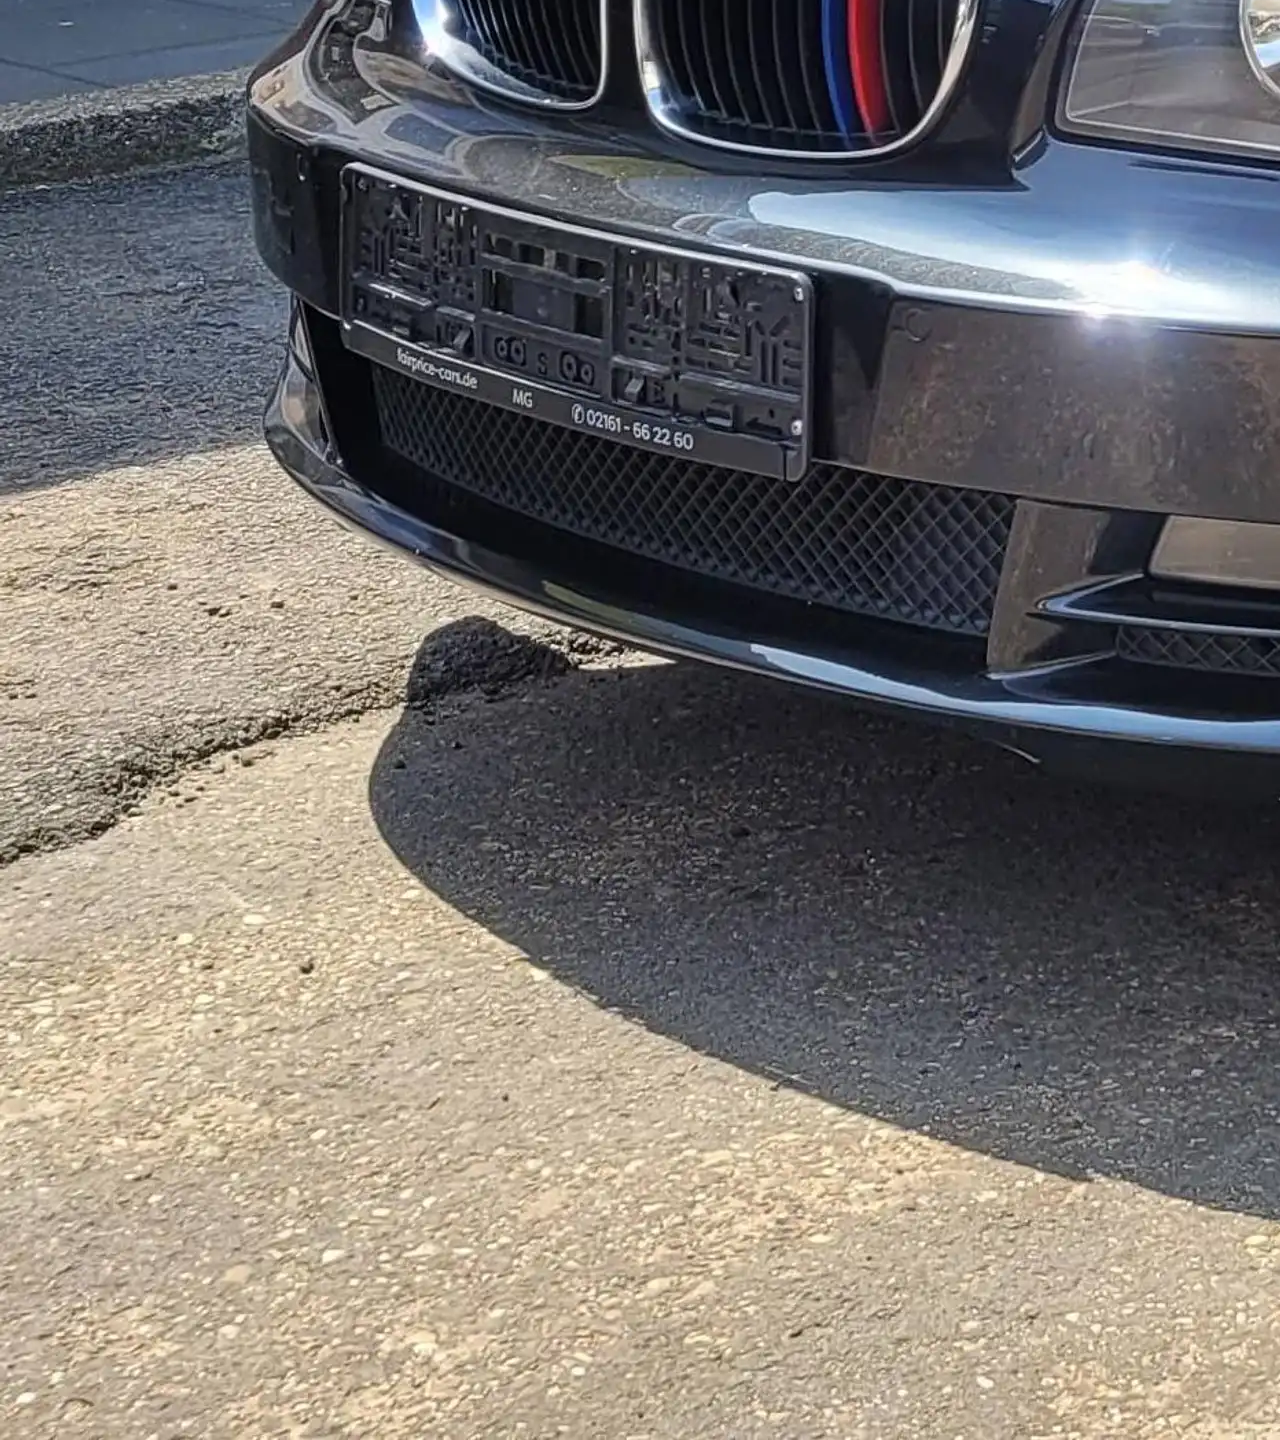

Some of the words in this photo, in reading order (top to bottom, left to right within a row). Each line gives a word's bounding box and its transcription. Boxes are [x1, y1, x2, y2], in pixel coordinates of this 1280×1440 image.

[396, 347, 478, 389] fairprice-cars.de
[512, 389, 534, 409] MG
[586, 409, 622, 434] 02161
[632, 422, 651, 441] 66
[652, 426, 672, 446] 22
[673, 430, 694, 451] 60
